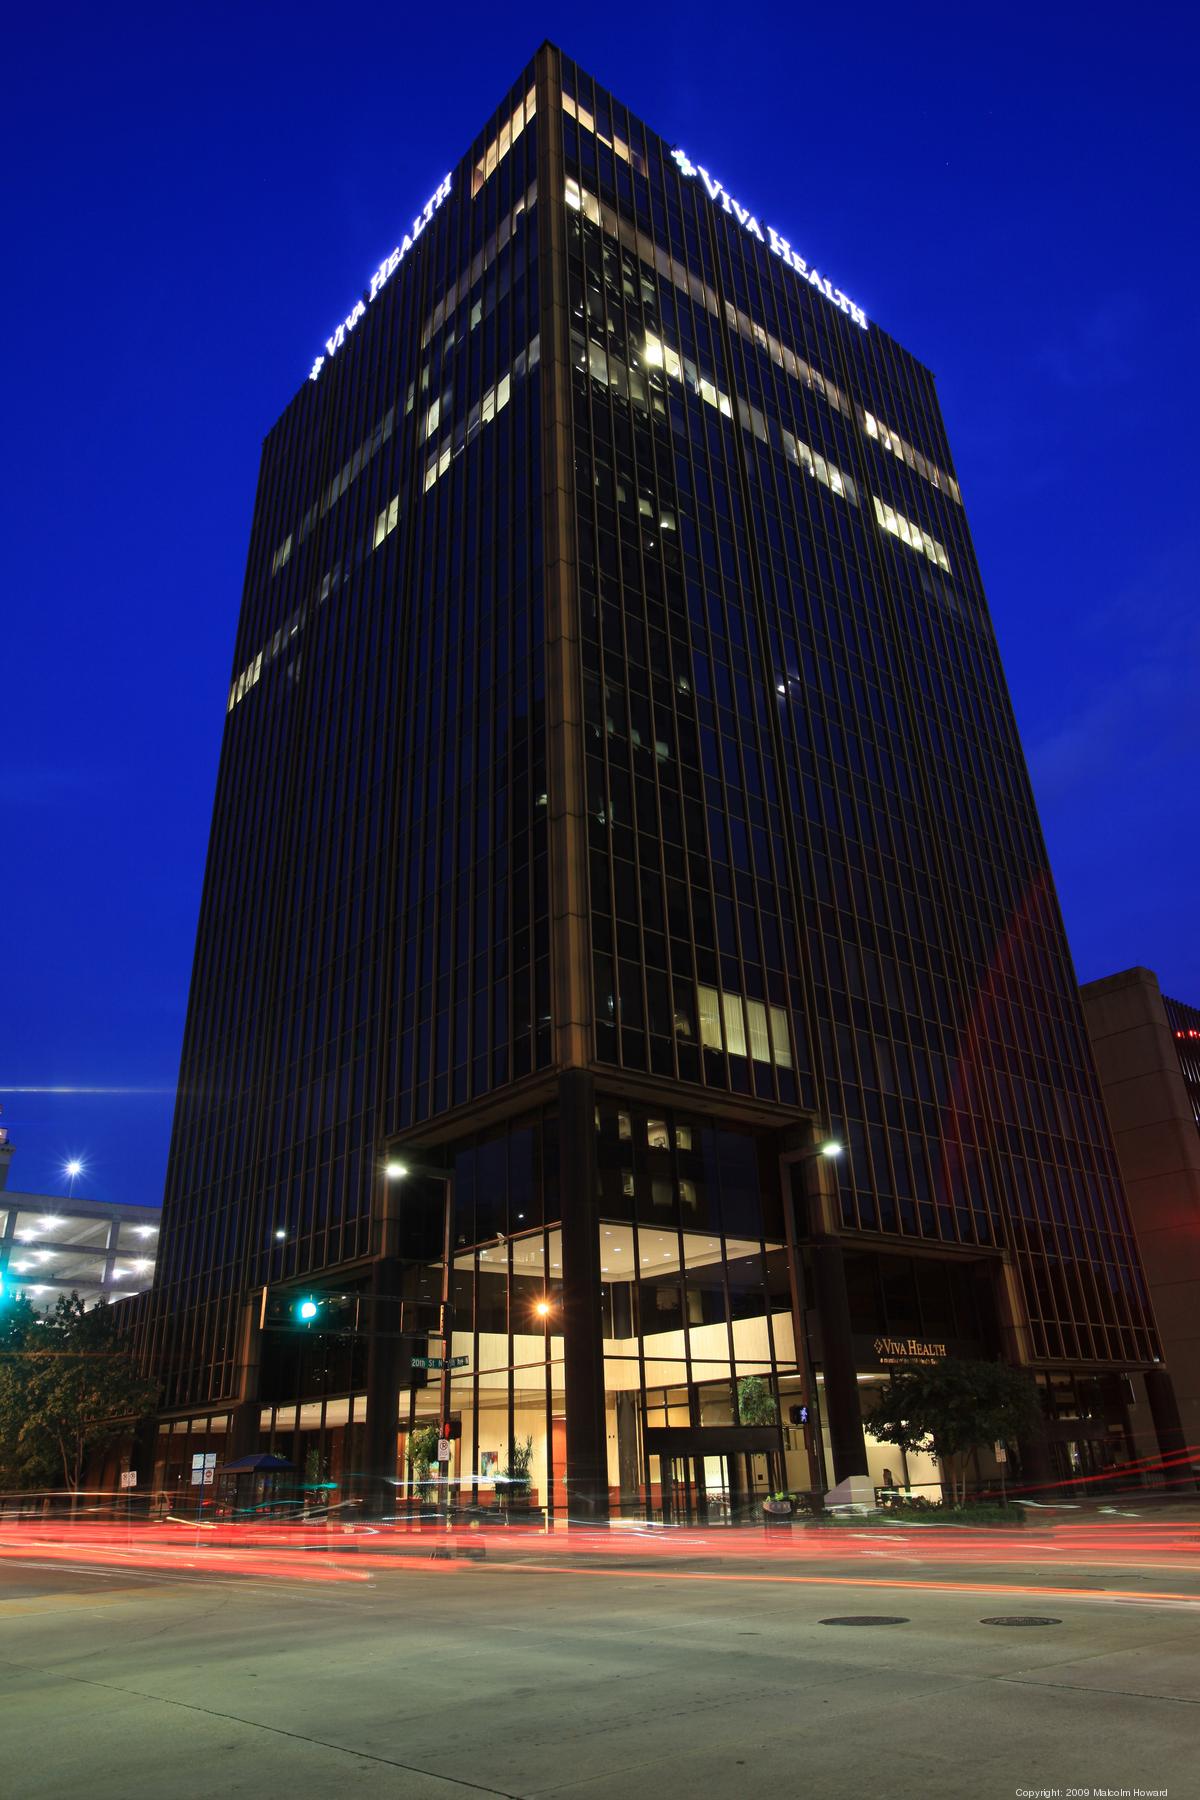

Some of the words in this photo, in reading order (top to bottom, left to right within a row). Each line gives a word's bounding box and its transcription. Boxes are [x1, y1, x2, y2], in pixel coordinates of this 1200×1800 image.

[325, 300, 366, 357] VIVA
[369, 171, 452, 303] HEALTH
[698, 165, 765, 243] VIVA
[767, 226, 868, 330] HEALTH
[411, 1358, 426, 1368] 20th
[428, 1359, 435, 1368] St
[882, 1338, 907, 1355] VIVA
[907, 1339, 946, 1356] HEALTH
